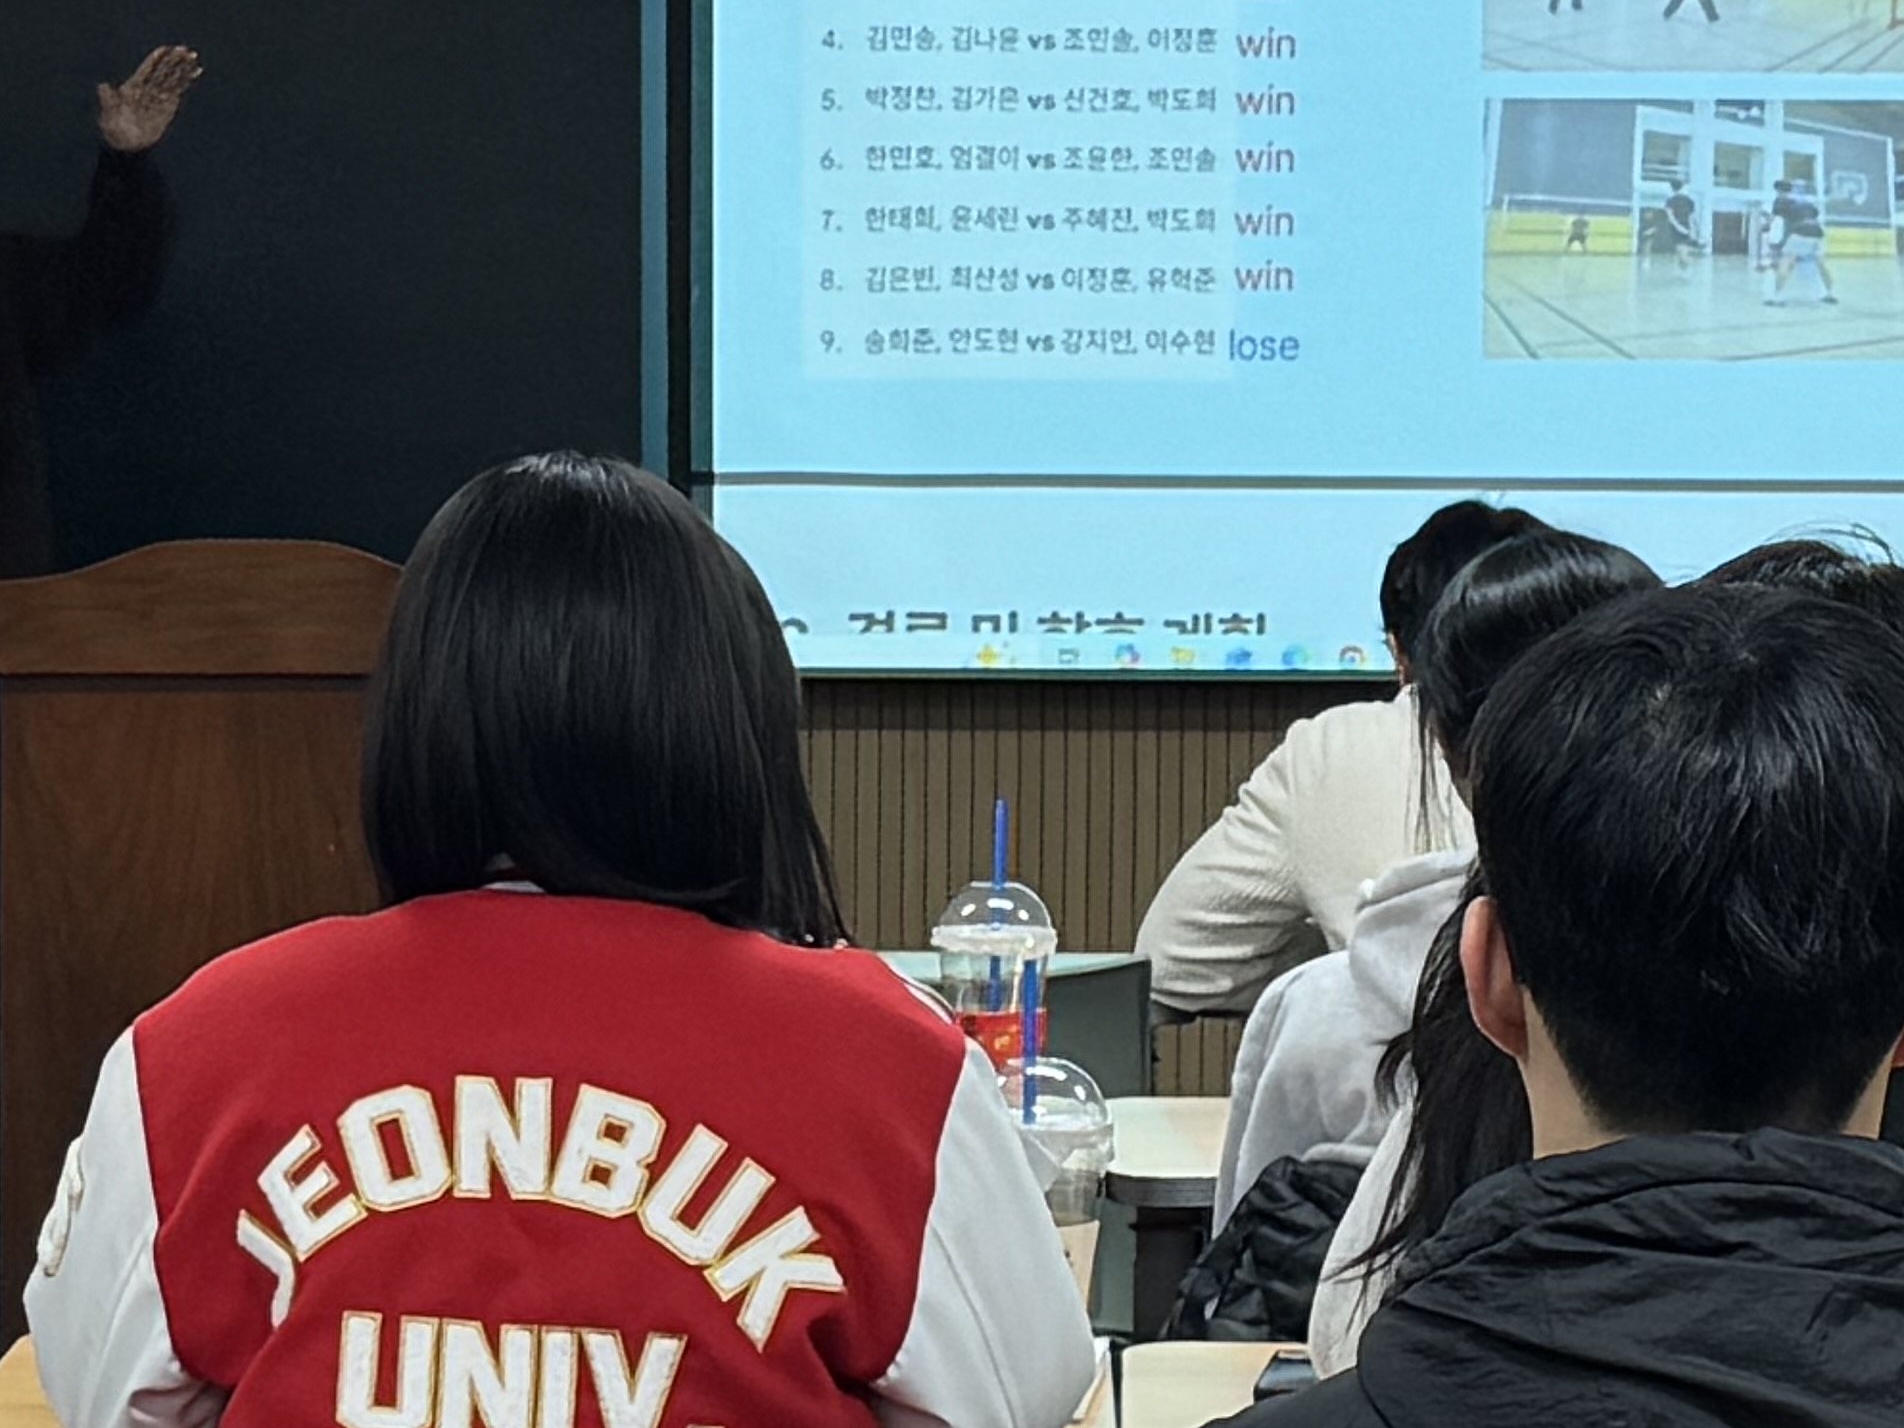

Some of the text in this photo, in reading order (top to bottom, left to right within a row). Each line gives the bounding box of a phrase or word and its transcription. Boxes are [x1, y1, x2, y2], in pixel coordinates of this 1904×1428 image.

[821, 29, 843, 50] 4.
[1027, 34, 1056, 51] vs
[1236, 26, 1295, 58] win
[821, 88, 843, 112] 5.
[1027, 94, 1056, 111] vs
[1236, 83, 1294, 115] win
[820, 148, 843, 170] 6.
[1026, 153, 1056, 170] vs
[1235, 140, 1294, 173] win
[822, 209, 843, 232] 7.
[1026, 214, 1055, 230] vs
[1235, 204, 1294, 236] win
[819, 268, 843, 291] 8.
[1026, 273, 1054, 290] vs
[1235, 259, 1293, 291] win
[820, 330, 842, 353] 9.
[1026, 335, 1055, 352] vs
[1230, 330, 1300, 361] lose
[237, 1074, 846, 1352] JEONBUK
